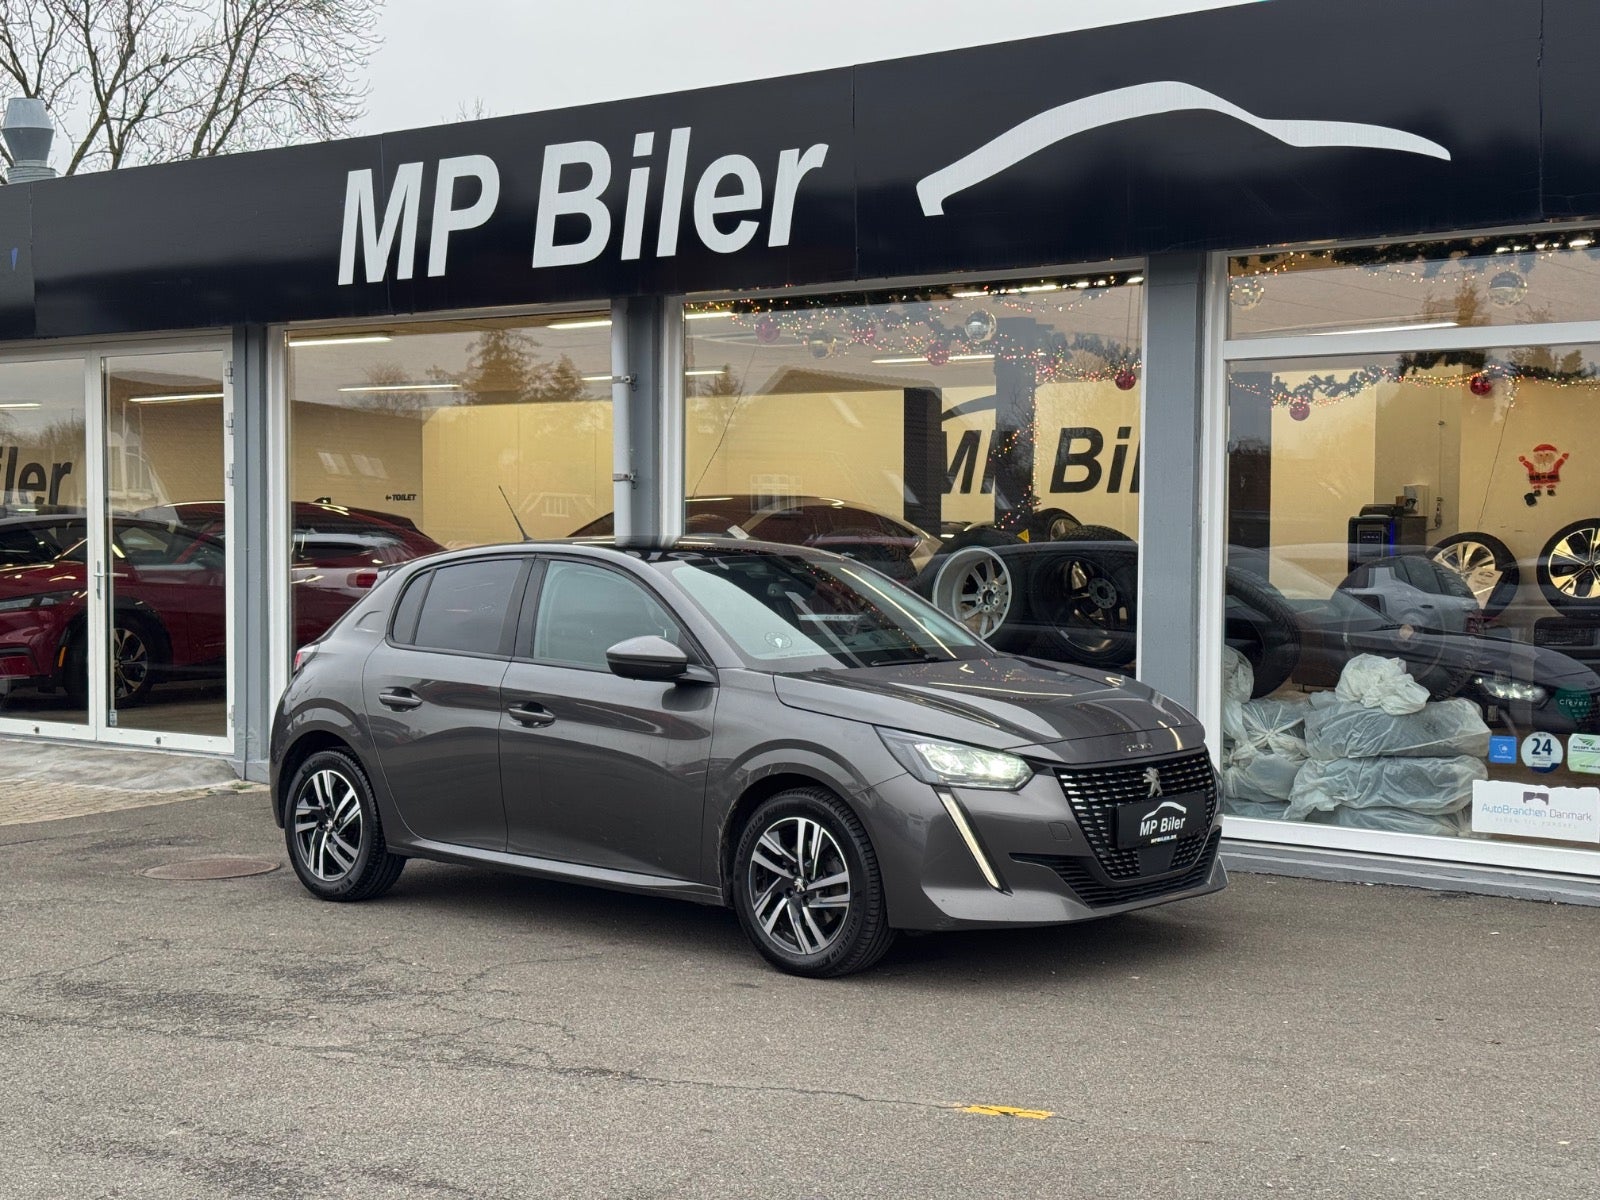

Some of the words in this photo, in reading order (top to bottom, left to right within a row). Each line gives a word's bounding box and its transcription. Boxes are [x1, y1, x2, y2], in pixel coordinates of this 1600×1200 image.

[338, 154, 501, 286] MP
[532, 126, 829, 269] Biler
[0, 446, 72, 506] ler
[392, 493, 417, 502] TOILET
[1531, 737, 1553, 756] 24
[1481, 803, 1547, 818] AutoBranchen
[1549, 808, 1592, 822] Danmark
[1139, 819, 1158, 837] MP
[1160, 816, 1186, 833] Biler
